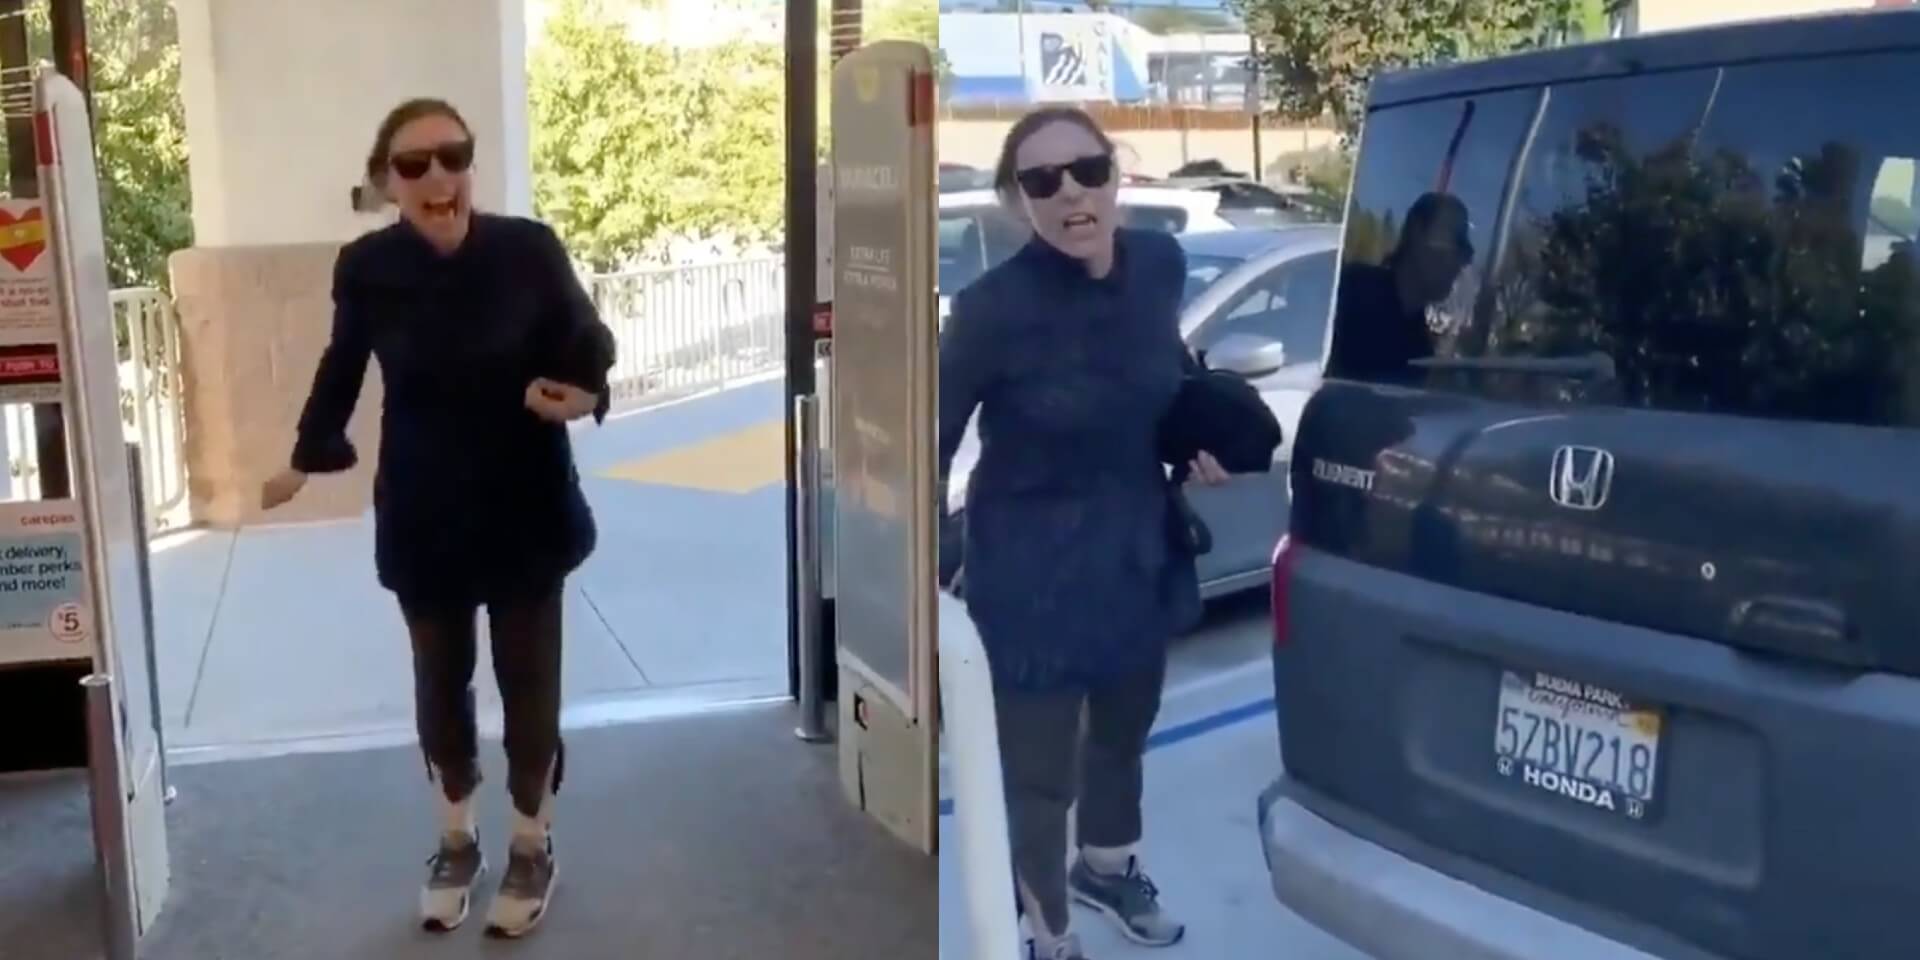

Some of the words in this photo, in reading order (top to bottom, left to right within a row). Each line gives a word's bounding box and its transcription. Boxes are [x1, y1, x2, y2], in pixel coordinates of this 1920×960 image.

[22, 576, 66, 592] more!
[1500, 705, 1650, 798] 5ZBV218
[1524, 763, 1615, 811] HONDA
